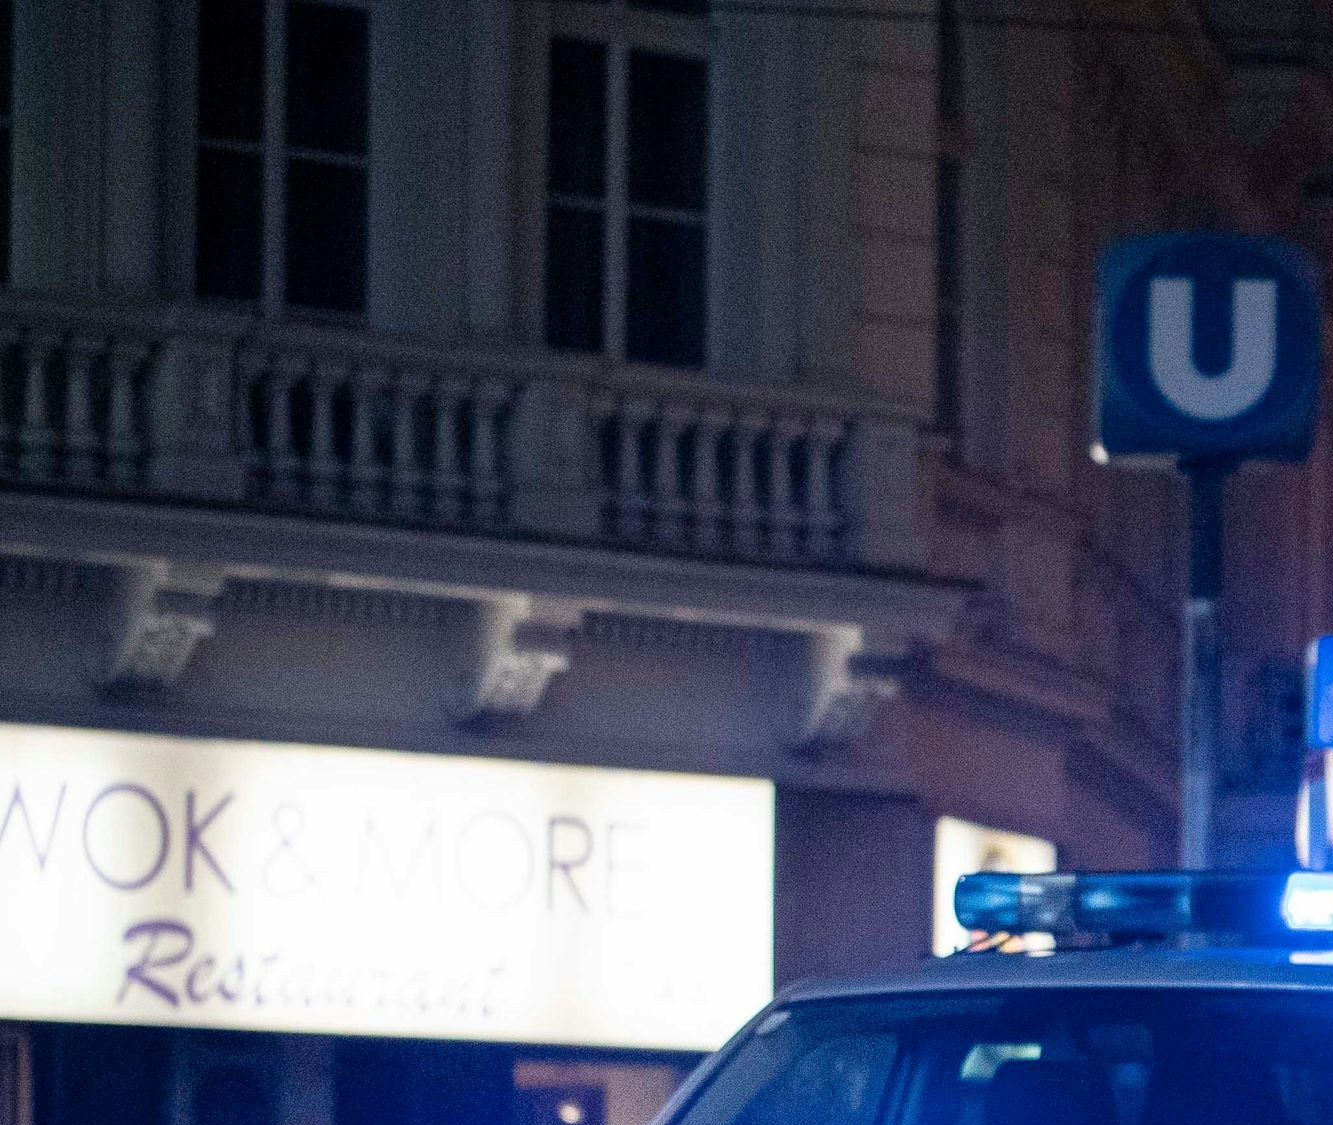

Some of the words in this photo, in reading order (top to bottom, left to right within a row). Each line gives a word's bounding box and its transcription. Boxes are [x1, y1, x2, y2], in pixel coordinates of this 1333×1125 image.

[1148, 276, 1278, 421] U
[0, 780, 236, 896] WOK
[261, 802, 327, 902] &
[353, 805, 649, 921] MORE
[113, 917, 509, 1018] Restaurant
